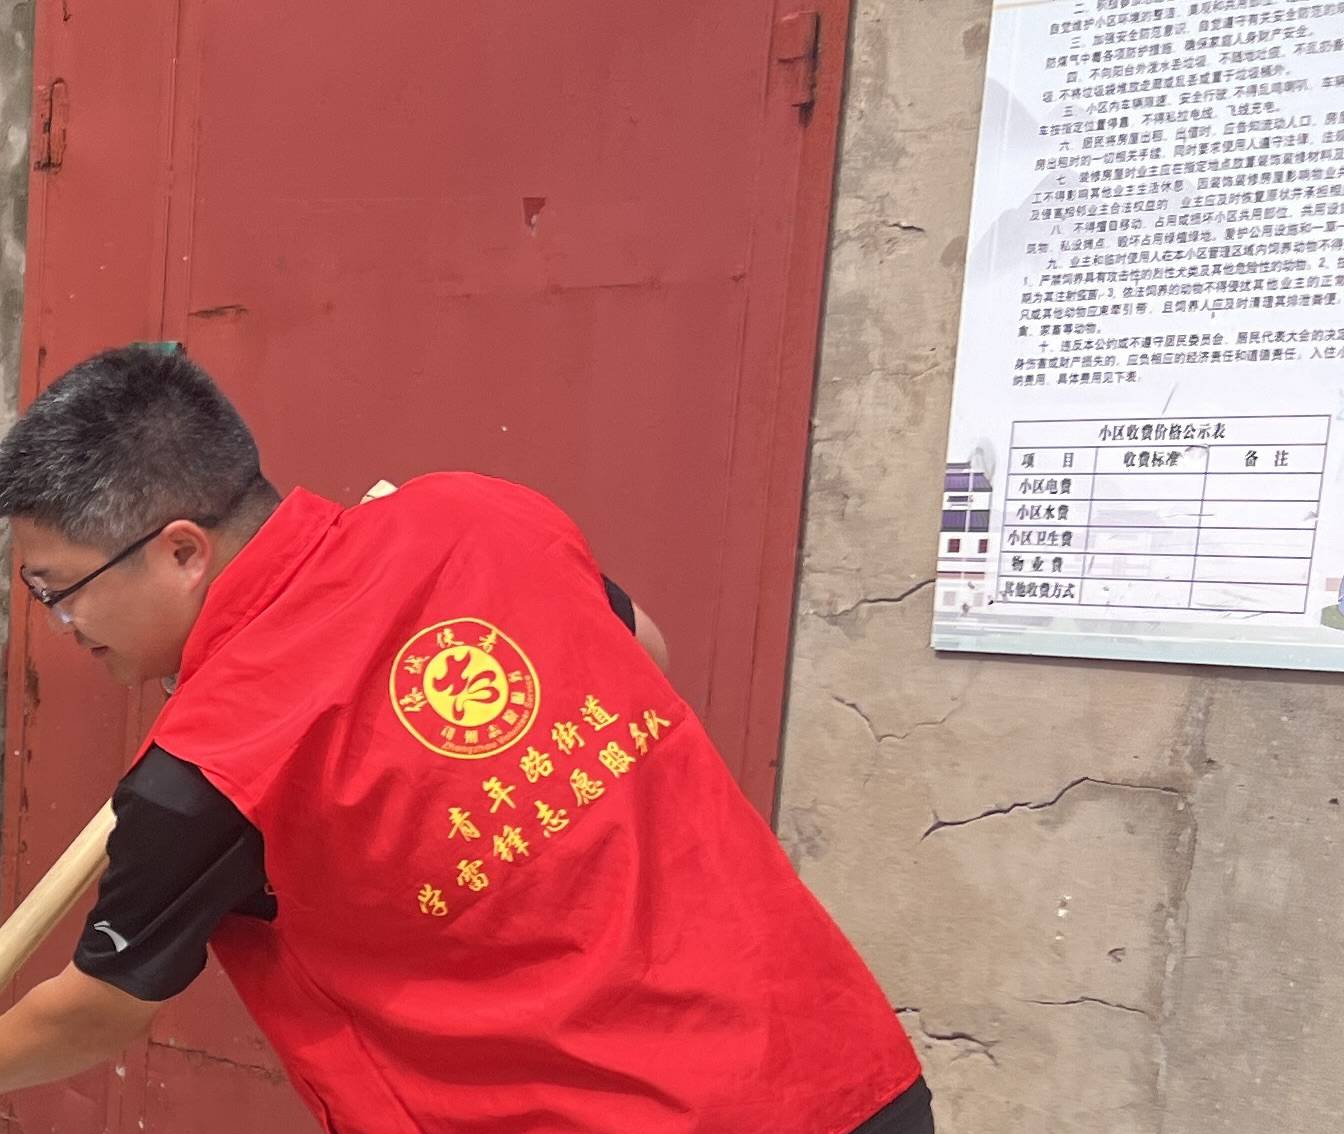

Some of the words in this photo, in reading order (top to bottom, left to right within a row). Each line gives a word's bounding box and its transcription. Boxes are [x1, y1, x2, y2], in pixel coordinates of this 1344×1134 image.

[1098, 423, 1226, 442] 小区收费价格公示表
[1123, 450, 1181, 468] 收费标准
[1019, 478, 1072, 495] 小区电费
[1016, 504, 1069, 521] 小区水费
[1008, 530, 1072, 548] 小区卫生费
[1000, 581, 1075, 600] 其他收费方式
[448, 695, 619, 841] 青年路街道
[418, 710, 671, 916] 学雷锋志愿服务队
